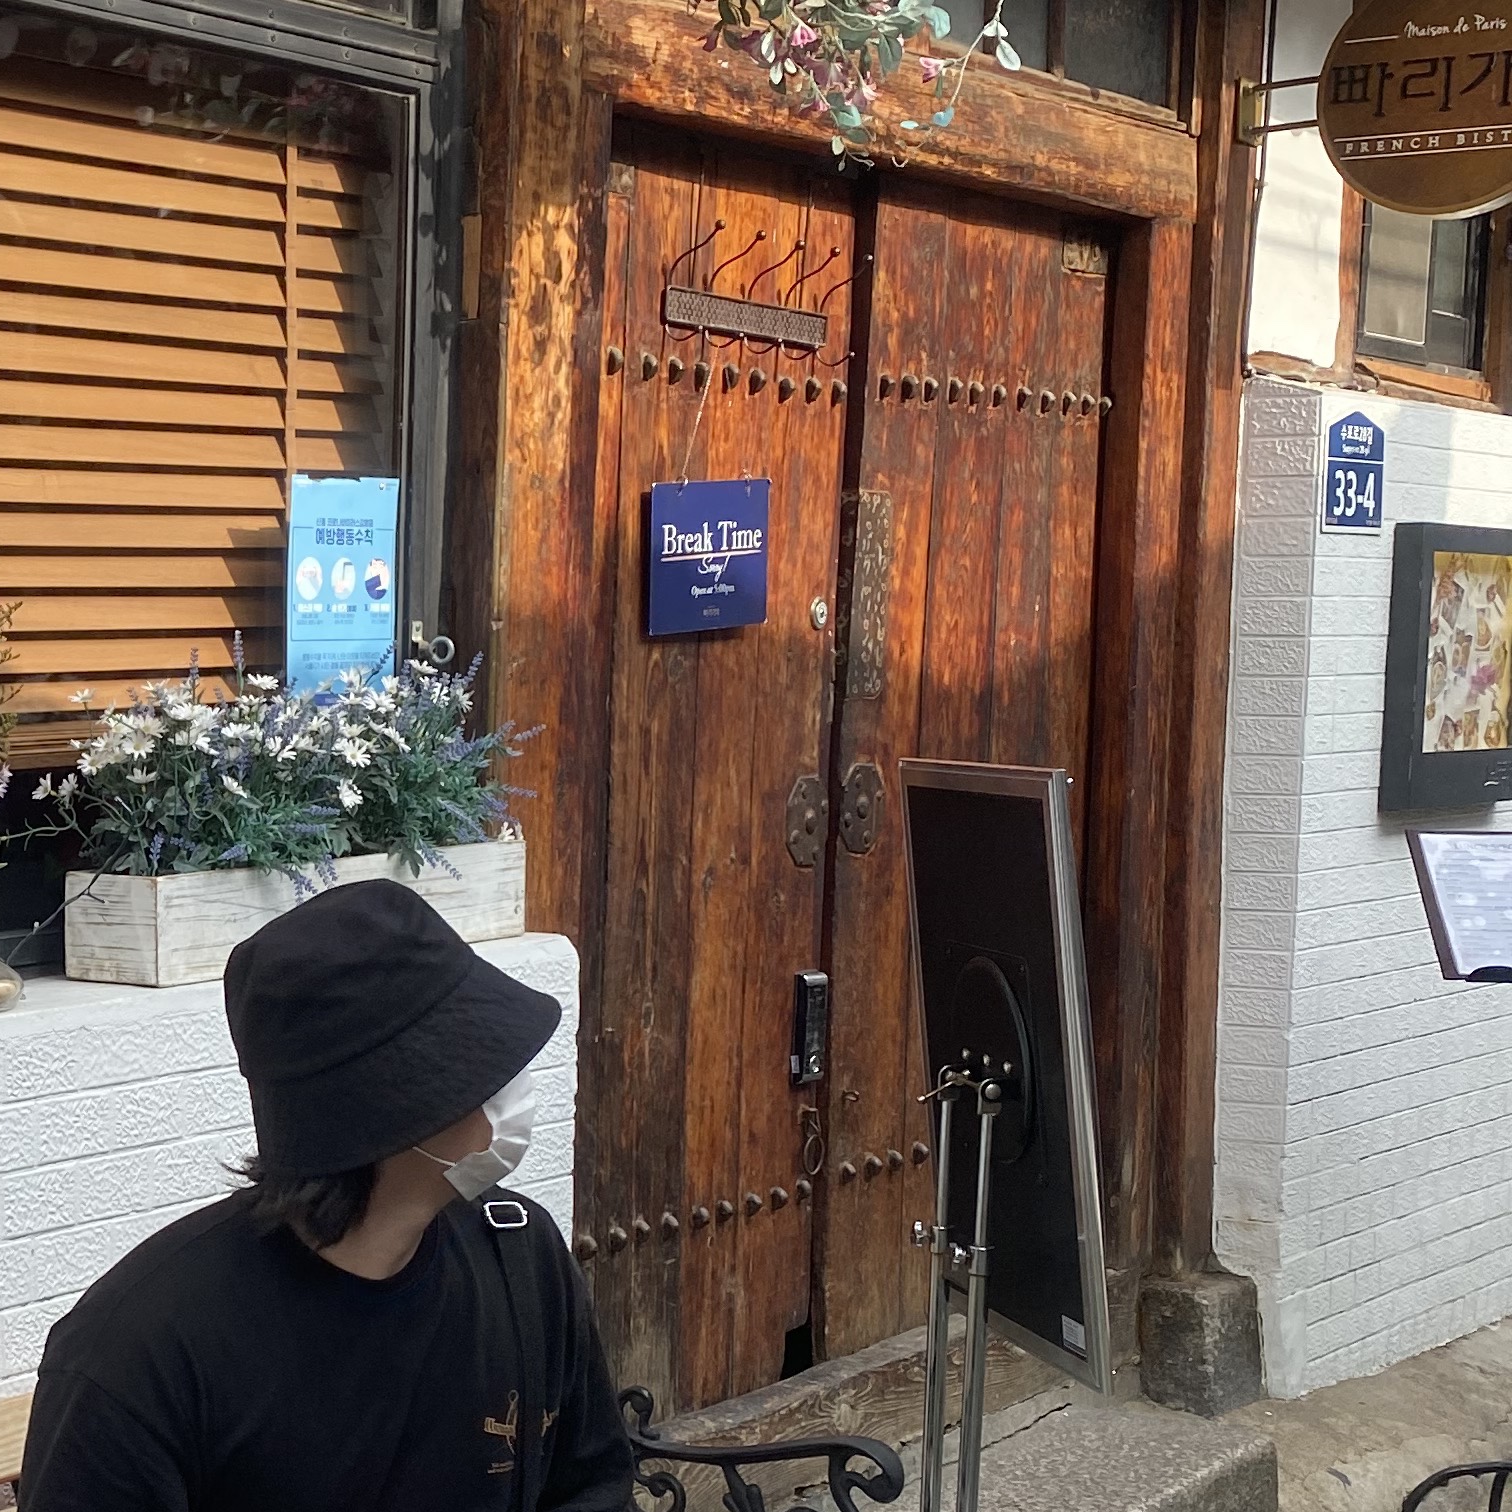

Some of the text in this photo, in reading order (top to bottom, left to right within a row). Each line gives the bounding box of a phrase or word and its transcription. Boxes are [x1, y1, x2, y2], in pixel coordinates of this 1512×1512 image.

[1404, 13, 1508, 38] Maison de Paris
[1344, 135, 1441, 154] FRENCH
[1333, 469, 1375, 518] 33-4
[315, 527, 374, 546] 예방행동수칙
[661, 520, 763, 555] Break Time
